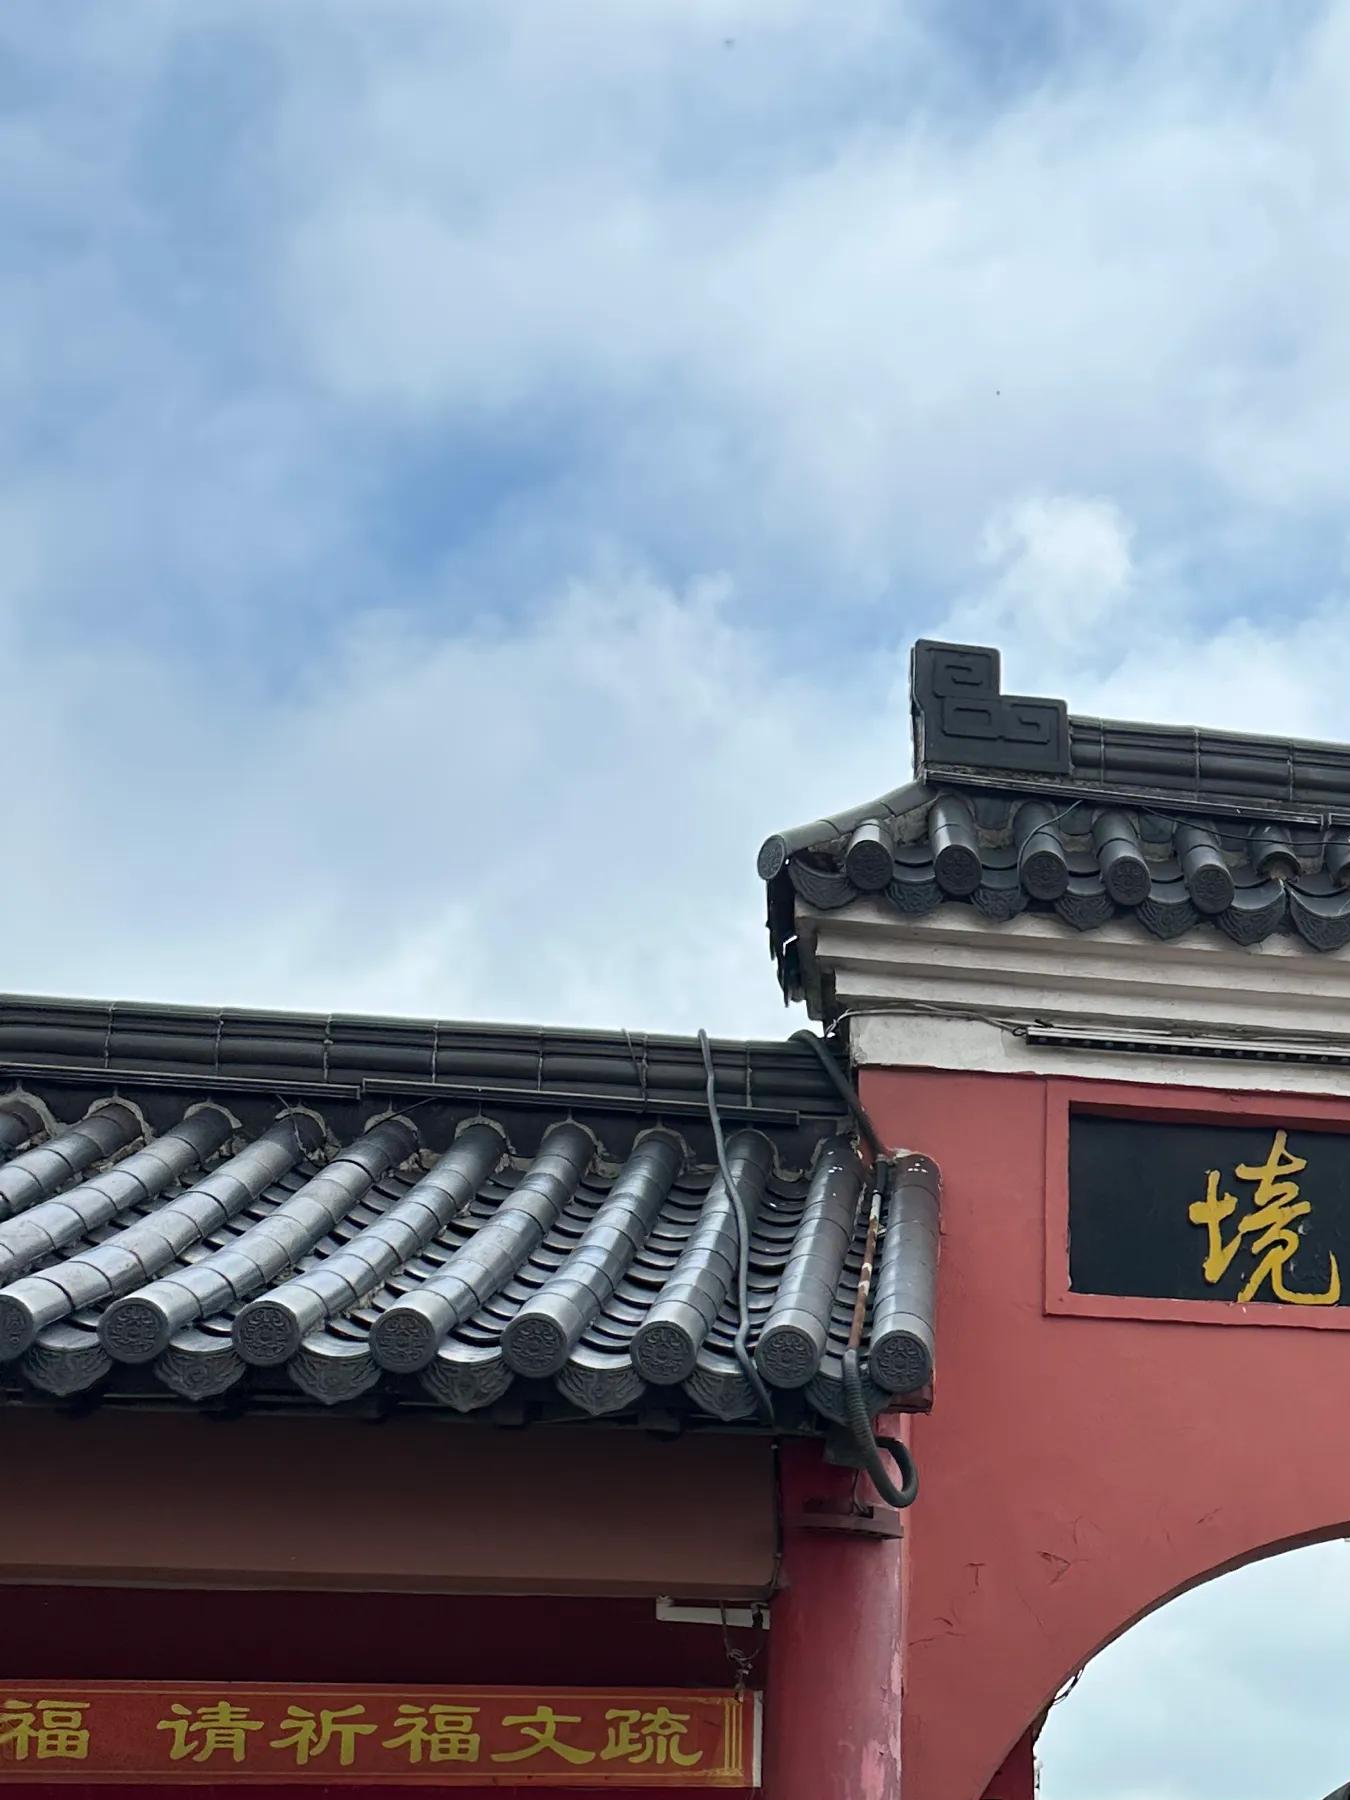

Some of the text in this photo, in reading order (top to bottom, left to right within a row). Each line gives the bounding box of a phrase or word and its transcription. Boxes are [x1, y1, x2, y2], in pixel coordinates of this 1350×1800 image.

[0, 1699, 703, 1768] 福 请祈福文疏
